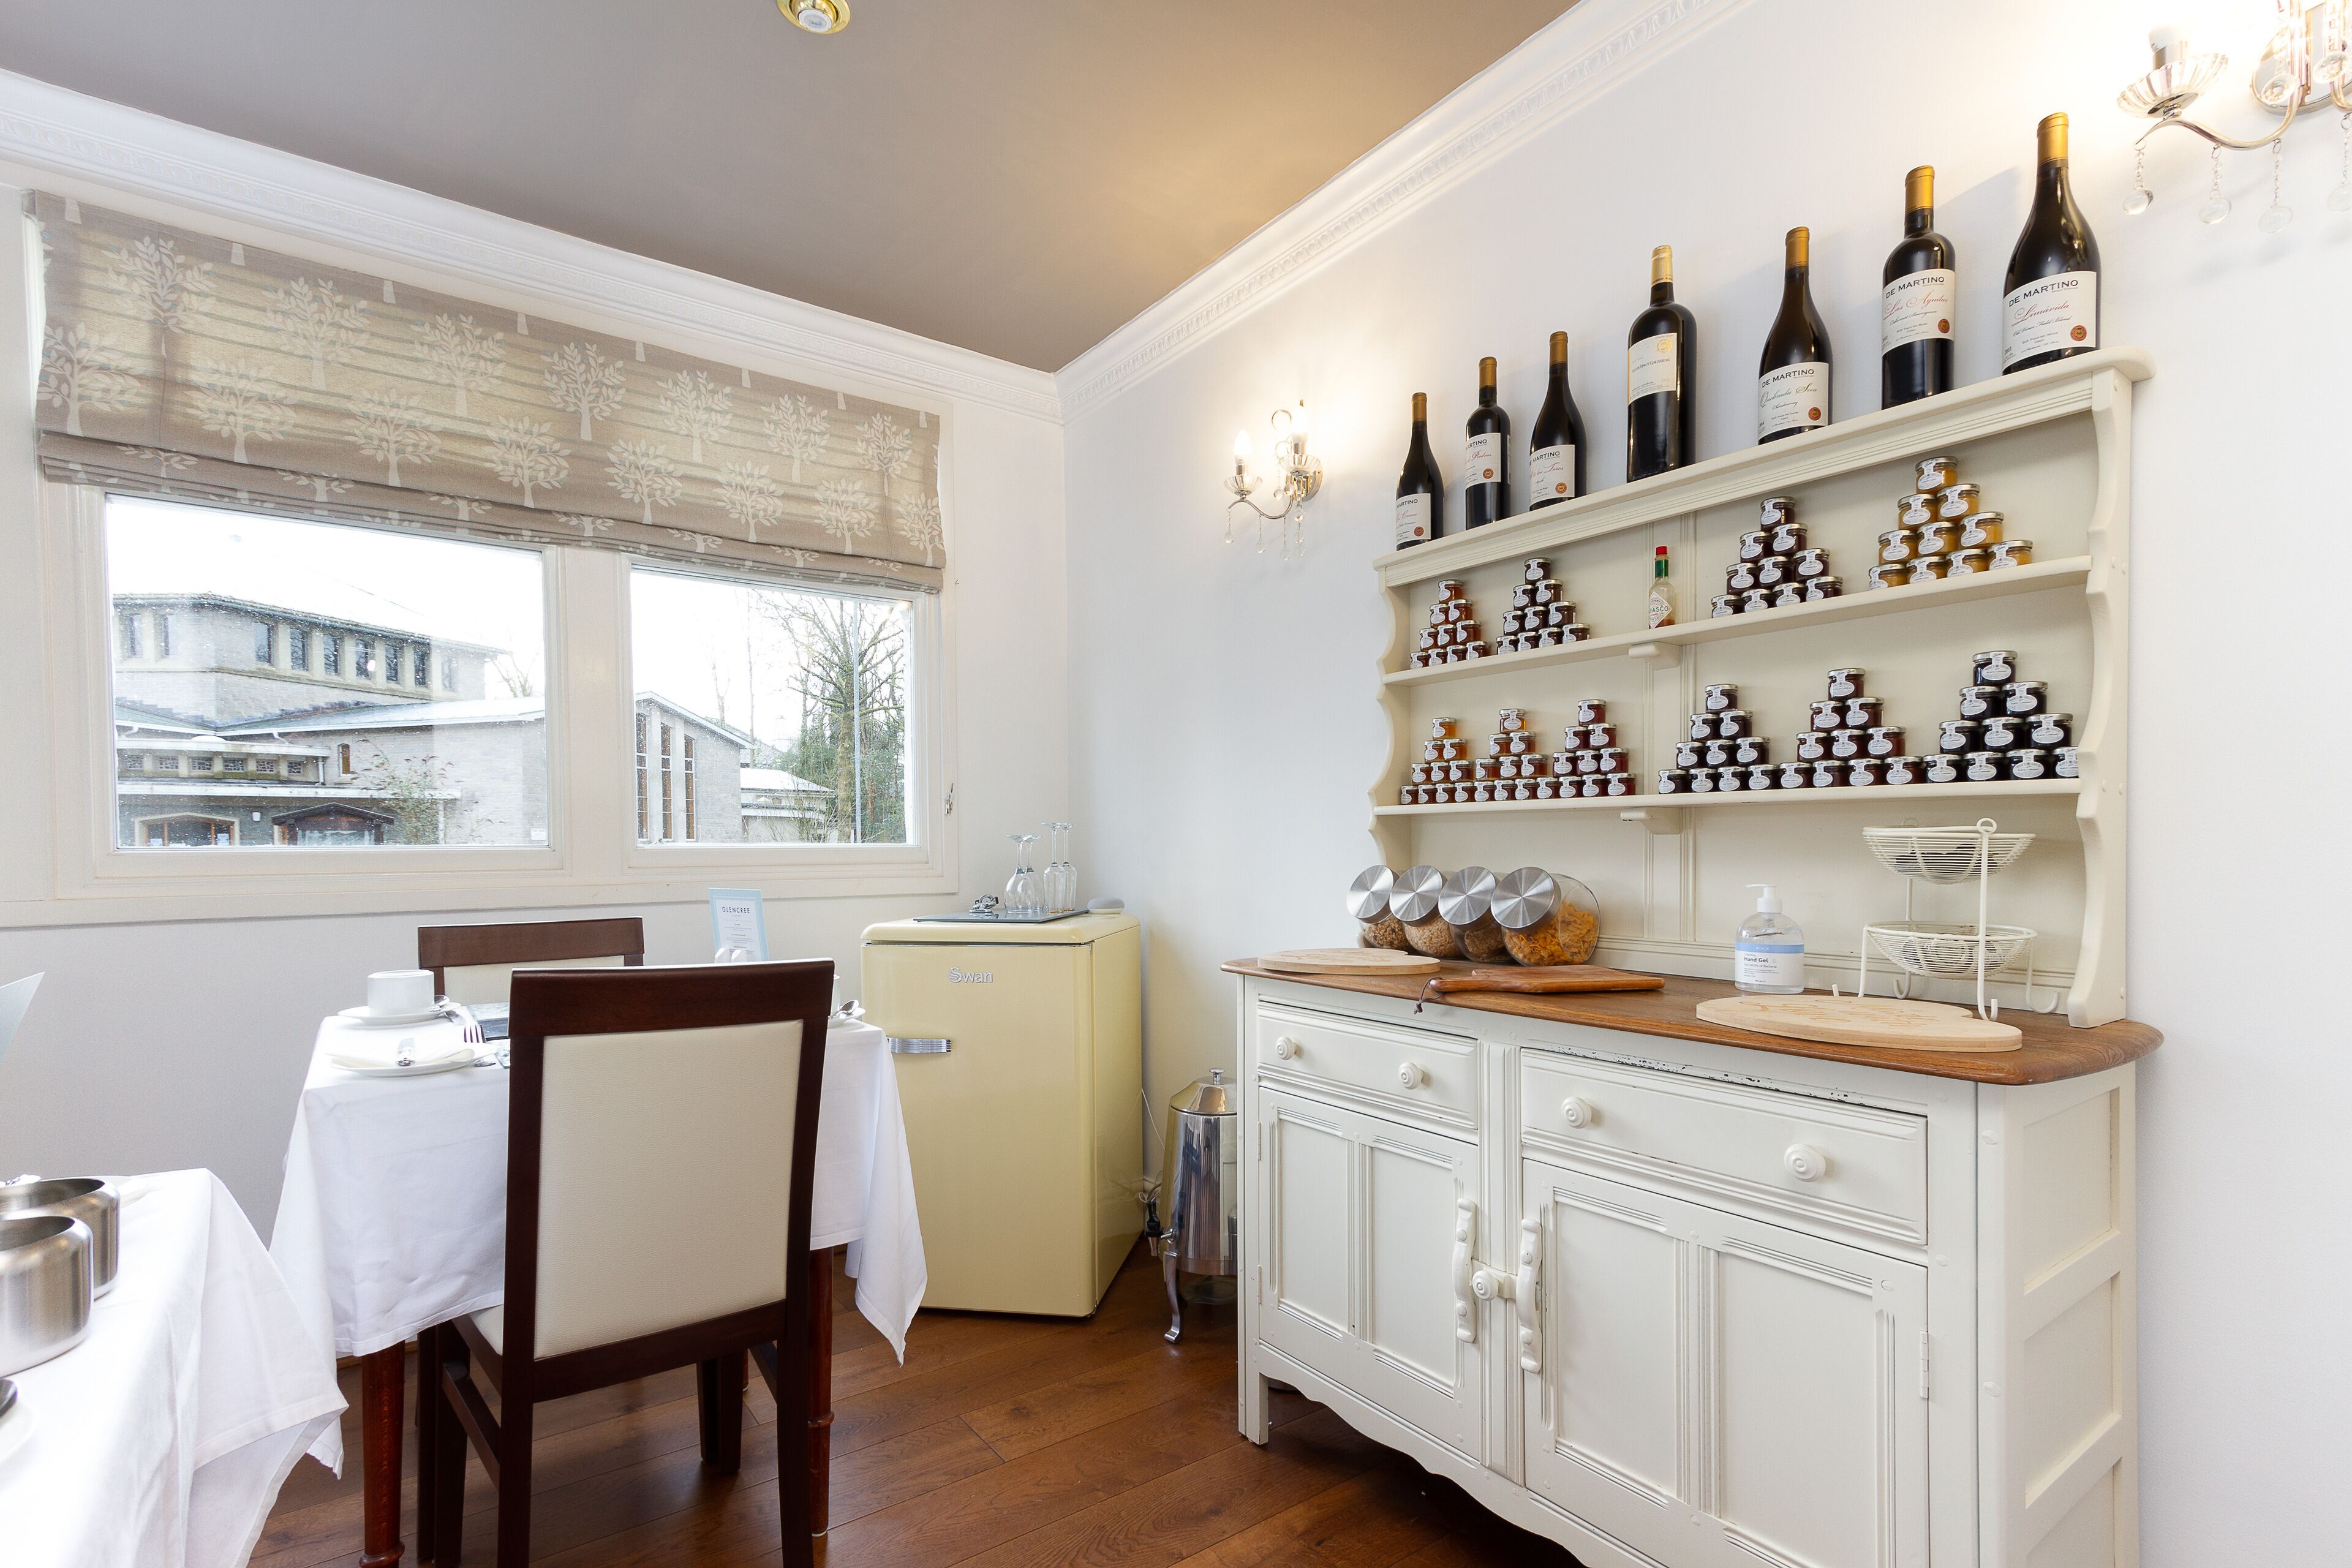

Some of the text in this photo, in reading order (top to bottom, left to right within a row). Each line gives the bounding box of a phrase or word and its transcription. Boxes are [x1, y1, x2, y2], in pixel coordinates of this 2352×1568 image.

[1886, 276, 1945, 299] DE MARTINO
[2009, 280, 2078, 307] DE MARTINO
[1762, 369, 1814, 388] DE MARTINO
[1532, 451, 1560, 463] MARTINO
[948, 967, 993, 983] Swan
